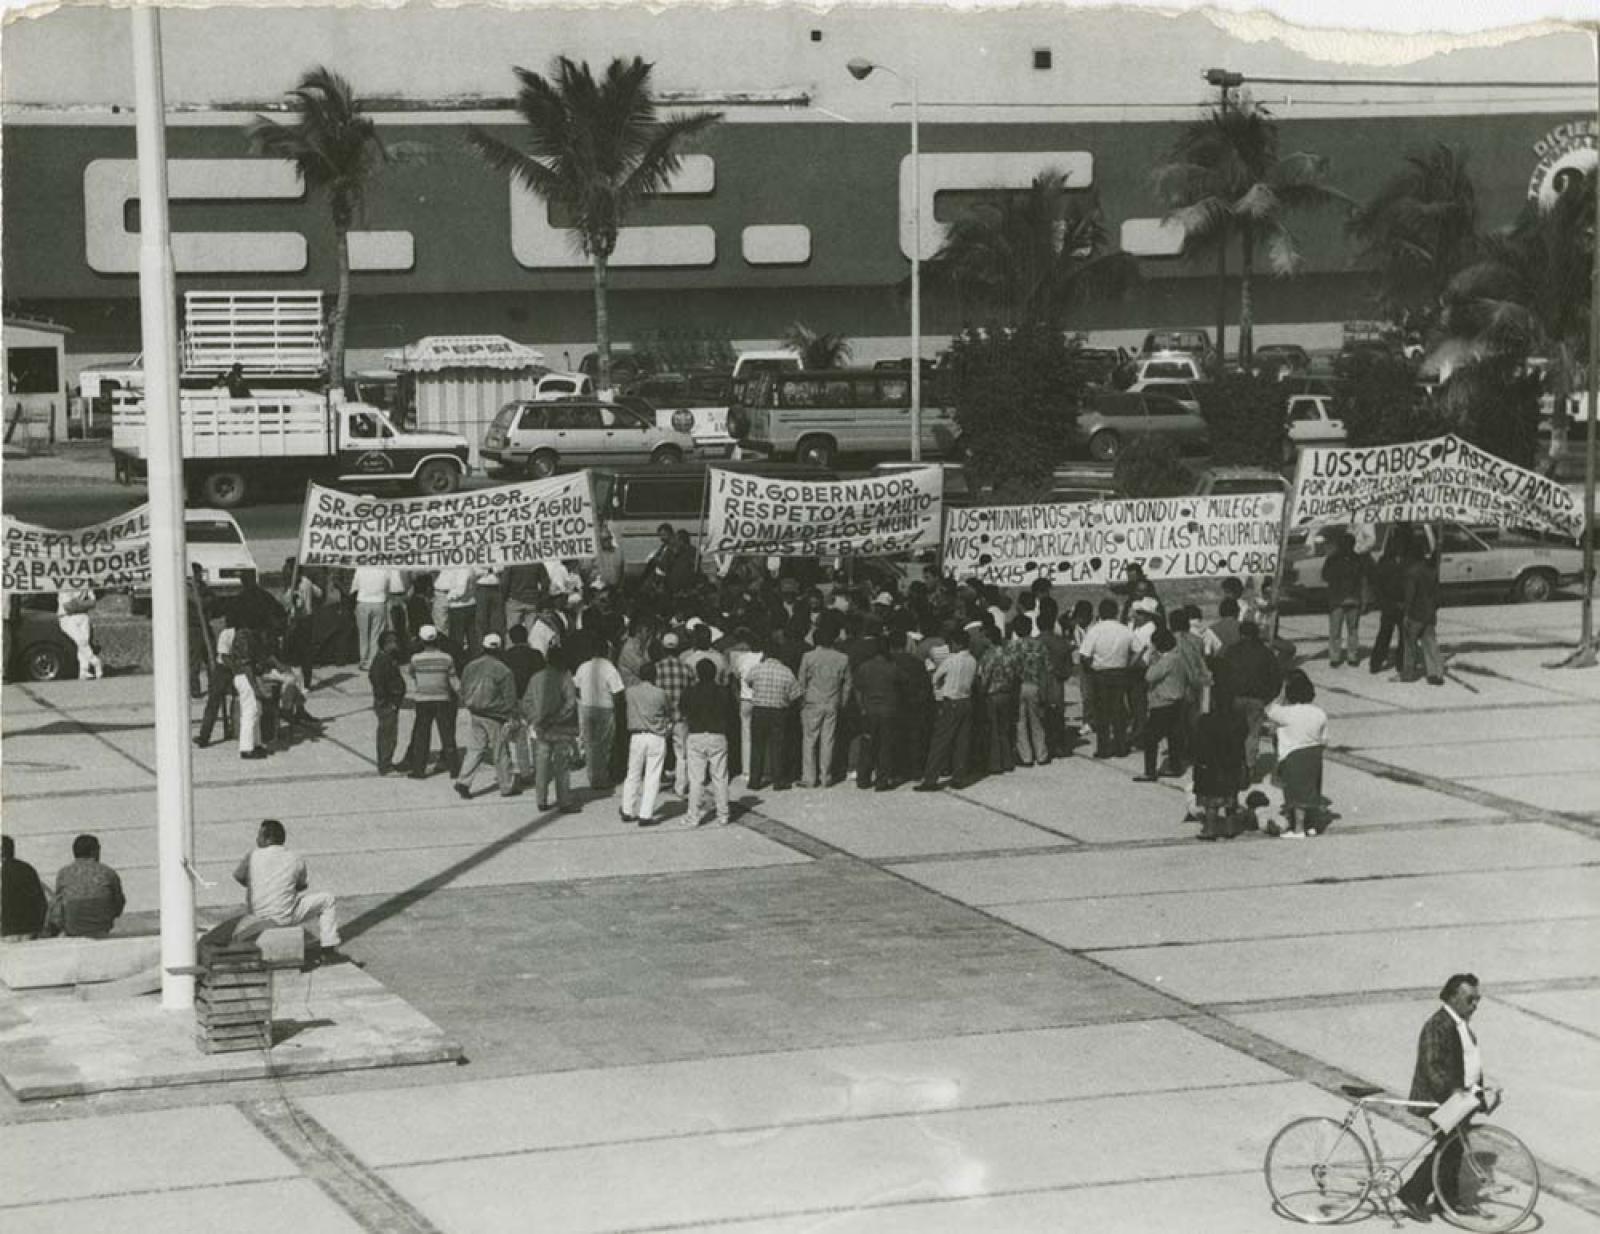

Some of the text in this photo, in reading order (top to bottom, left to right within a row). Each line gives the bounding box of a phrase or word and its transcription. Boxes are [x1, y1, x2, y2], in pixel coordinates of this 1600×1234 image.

[1313, 450, 1353, 478] LOS
[1361, 444, 1430, 475] CABOS
[724, 497, 835, 521] RESPETO
[842, 505, 855, 521] A
[863, 502, 885, 519] LA
[950, 508, 980, 532] LOS
[1103, 500, 1178, 526] COMONDU
[1190, 501, 1201, 519] Y
[1206, 497, 1262, 519] MULEGE
[309, 531, 412, 552] PACIONES
[447, 525, 507, 546] TAXIS
[511, 523, 536, 542] EN
[540, 520, 561, 540] EL
[465, 545, 497, 565] DEL
[500, 537, 593, 561] TRANSPORTE
[945, 535, 980, 560] NOS
[991, 528, 1118, 559] SOLIDARIZAMOS
[1127, 526, 1157, 552] CON
[1160, 524, 1191, 550] LAS
[2, 573, 44, 591] DEL
[1071, 561, 1092, 582] LA
[1164, 553, 1180, 575] Y
[1185, 551, 1220, 575] LOS
[1227, 550, 1278, 574] CABOS
